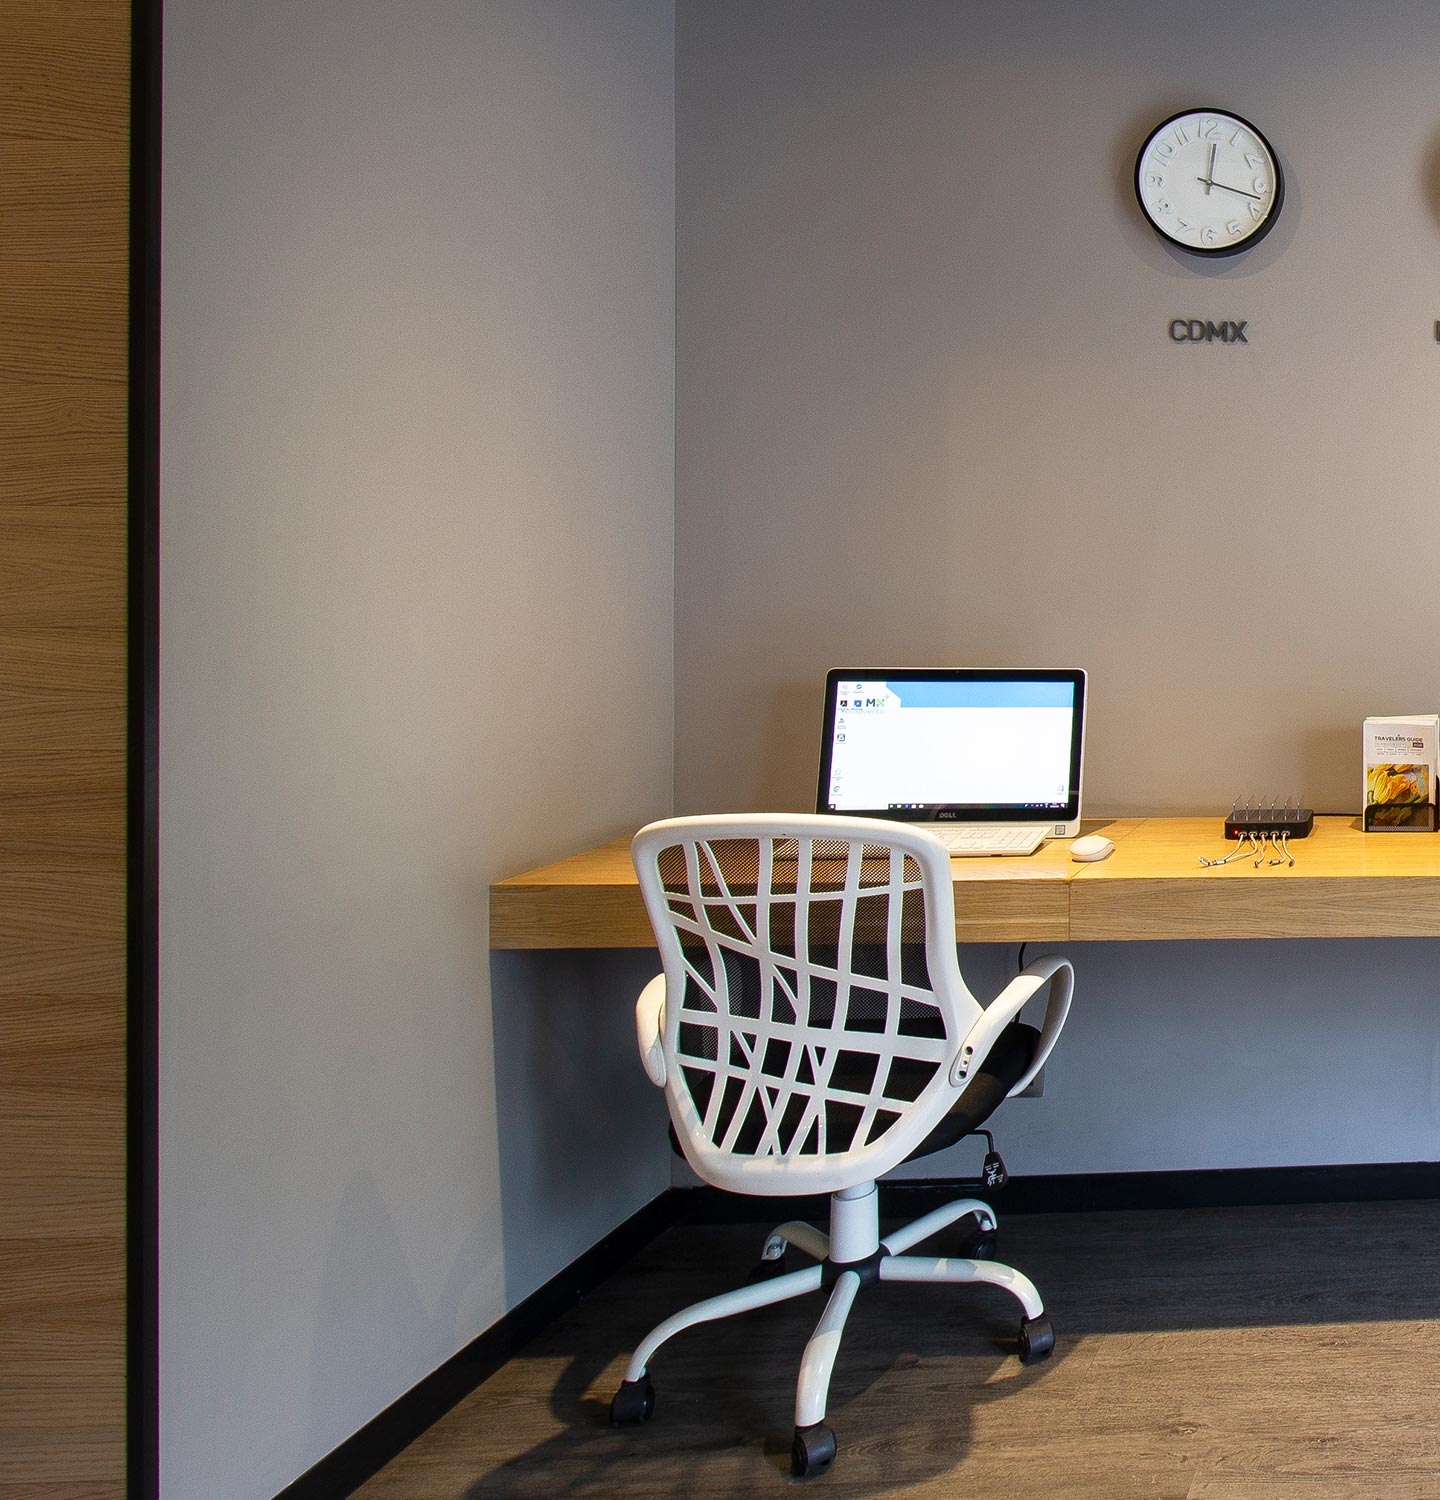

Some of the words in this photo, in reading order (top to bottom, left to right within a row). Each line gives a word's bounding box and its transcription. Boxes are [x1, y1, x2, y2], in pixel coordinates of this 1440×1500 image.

[1172, 125, 1191, 146] 11
[1197, 119, 1223, 140] 12
[1151, 140, 1177, 167] 10
[1244, 150, 1266, 170] 2
[1175, 218, 1195, 234] 7
[1227, 219, 1242, 240] 5
[1201, 227, 1218, 247] 6
[1170, 320, 1249, 343] CDMX
